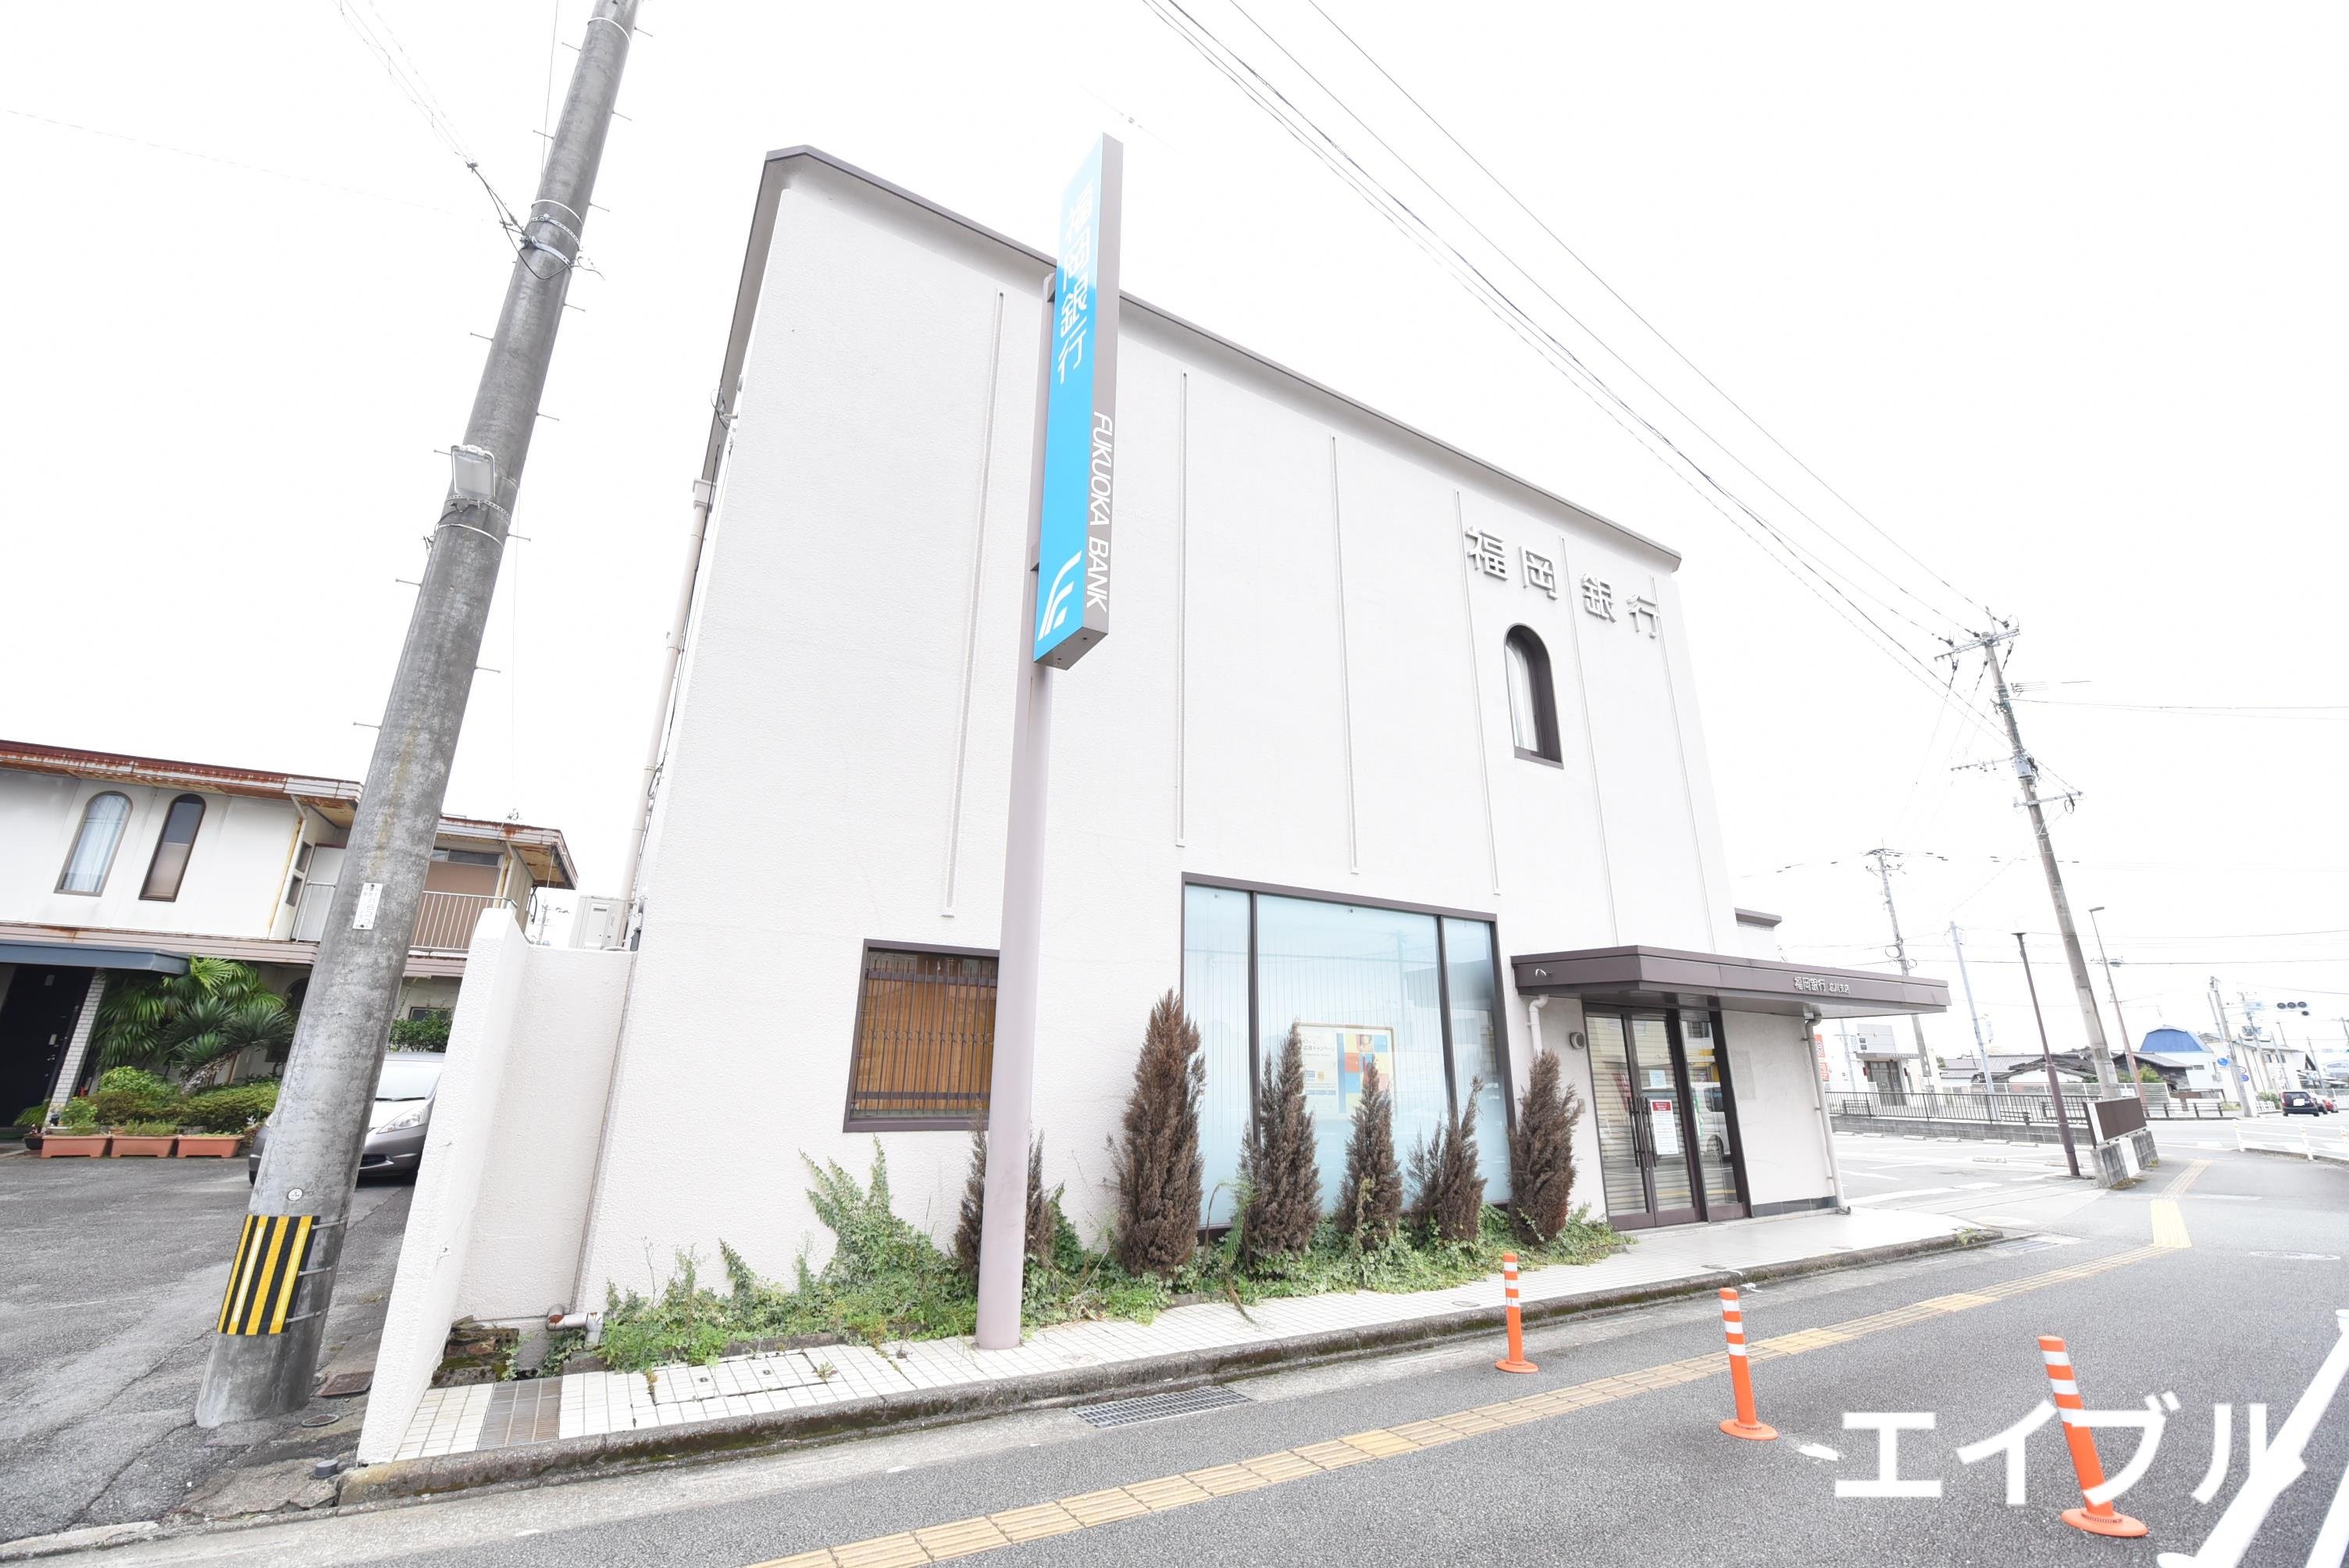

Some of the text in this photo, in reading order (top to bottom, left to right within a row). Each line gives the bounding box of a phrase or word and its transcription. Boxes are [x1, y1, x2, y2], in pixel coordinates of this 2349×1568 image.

[1058, 180, 1093, 384] 福岡銀行
[1086, 411, 1113, 613] FUKUOKA BANK
[1464, 526, 1659, 639] 福岡銀行
[1794, 976, 1826, 992] 福岡銀行
